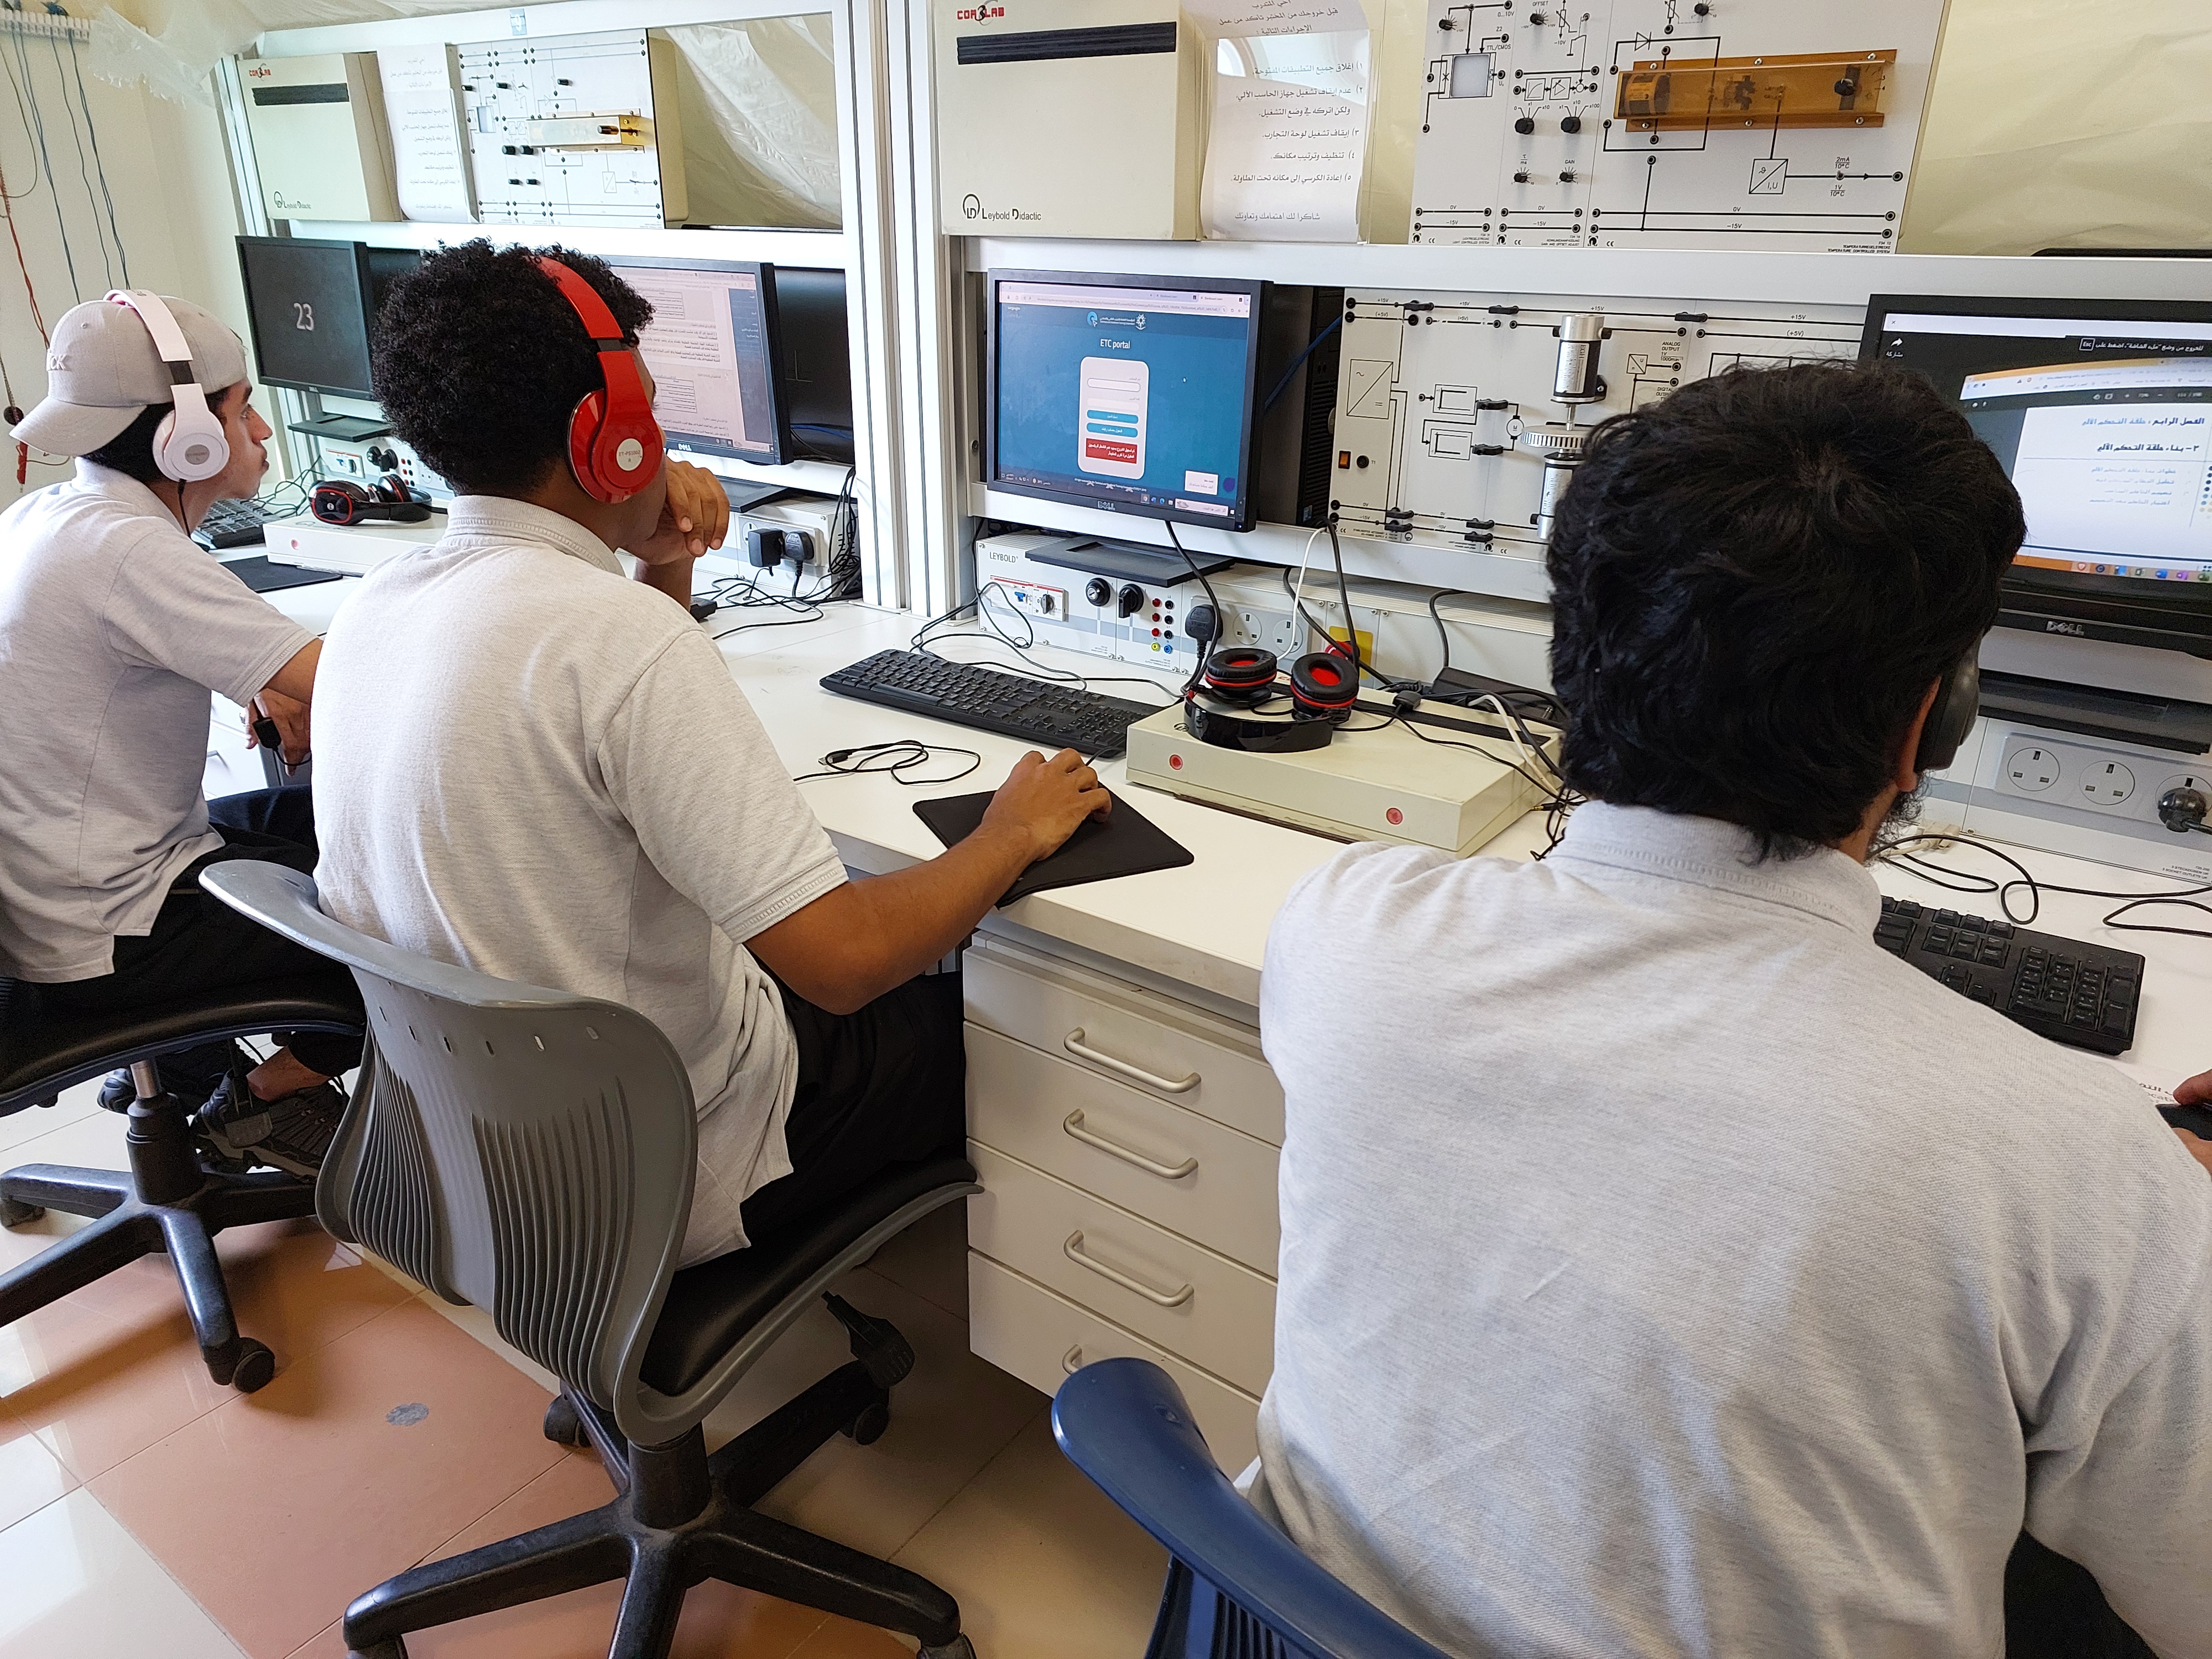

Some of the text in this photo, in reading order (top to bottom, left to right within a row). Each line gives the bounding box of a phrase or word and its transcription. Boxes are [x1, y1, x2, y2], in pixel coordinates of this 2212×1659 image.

[1261, 27, 1279, 35] التالية
[1282, 65, 1314, 75] التطبيقات
[1316, 65, 1334, 75] جميع
[1335, 63, 1354, 74] إغلاق
[1254, 90, 1279, 100] الحاسب
[1279, 91, 1295, 100] جهاز
[1296, 89, 1317, 98] تشغيل
[1318, 87, 1337, 97] إيقاف
[1339, 88, 1352, 97] عدم
[1287, 109, 1303, 118] وضع
[1304, 107, 1311, 116] في
[1313, 106, 1333, 114] اتركه
[1308, 129, 1329, 138] تشغيل
[1331, 129, 1349, 138] إيقاف
[1297, 152, 1319, 161] وترتيب
[1321, 152, 1344, 161] تنظيف
[1291, 174, 1300, 183] إلى
[1301, 174, 1325, 184] الكرسي
[1326, 174, 1342, 182] إعادة
[982, 207, 1010, 221] Leybold
[1012, 208, 1041, 220] Didactic
[1235, 212, 1258, 221] وتعاونك
[1298, 212, 1320, 222] شاكرا
[294, 302, 314, 331] 23
[1100, 338, 1130, 350] ETC portal
[2180, 418, 2205, 426] الفصل
[2114, 444, 2144, 452] التحكم
[1098, 501, 1115, 510] DELL
[2046, 621, 2084, 635] DELL
